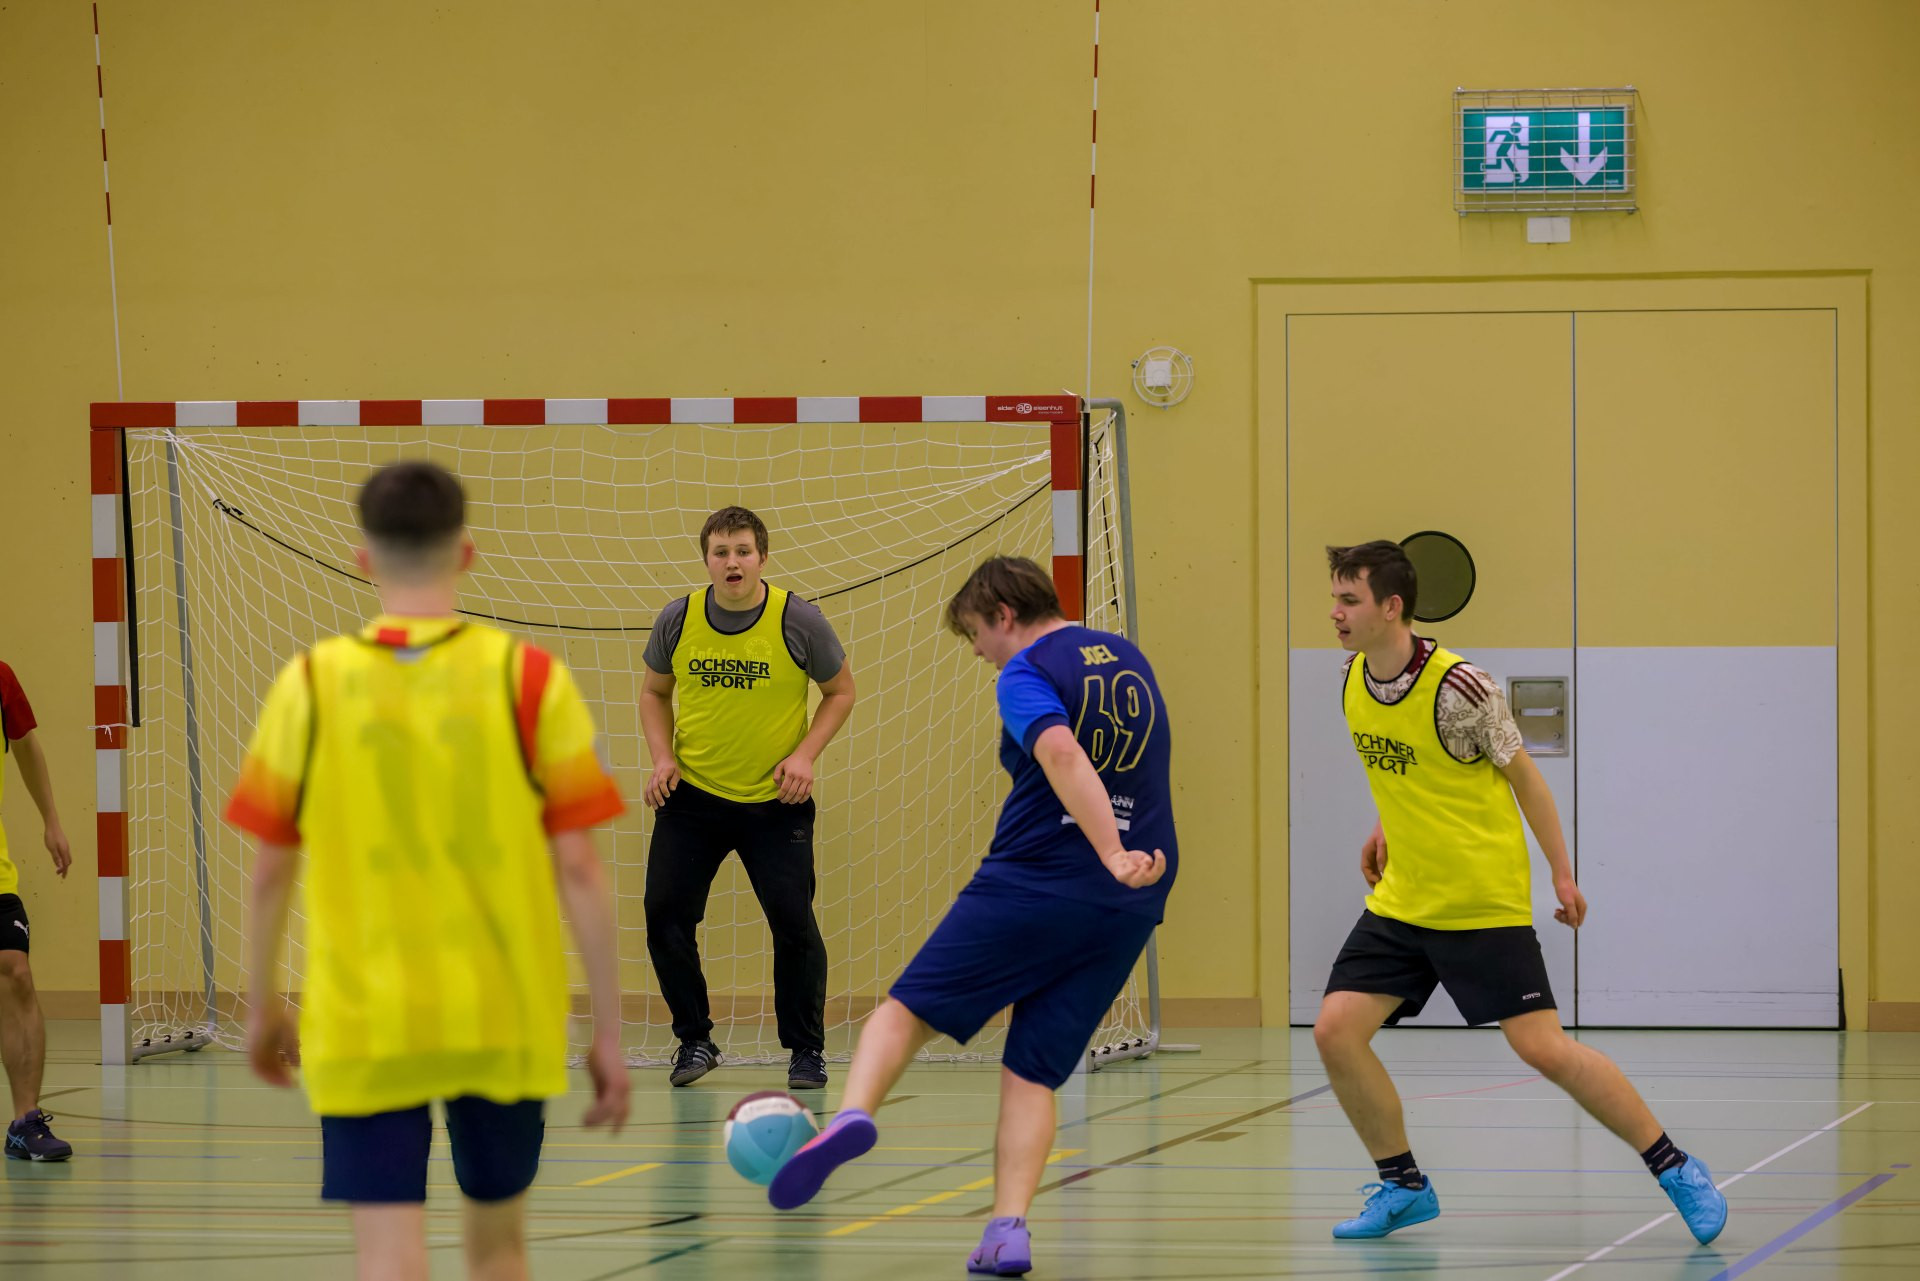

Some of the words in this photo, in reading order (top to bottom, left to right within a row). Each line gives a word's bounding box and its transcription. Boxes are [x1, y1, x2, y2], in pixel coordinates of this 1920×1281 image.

[1078, 644, 1119, 666] JOEL
[688, 658, 770, 676] OCHSNER
[701, 674, 757, 690] SPORT
[1074, 669, 1155, 774] 69
[1364, 753, 1409, 776] PORT
